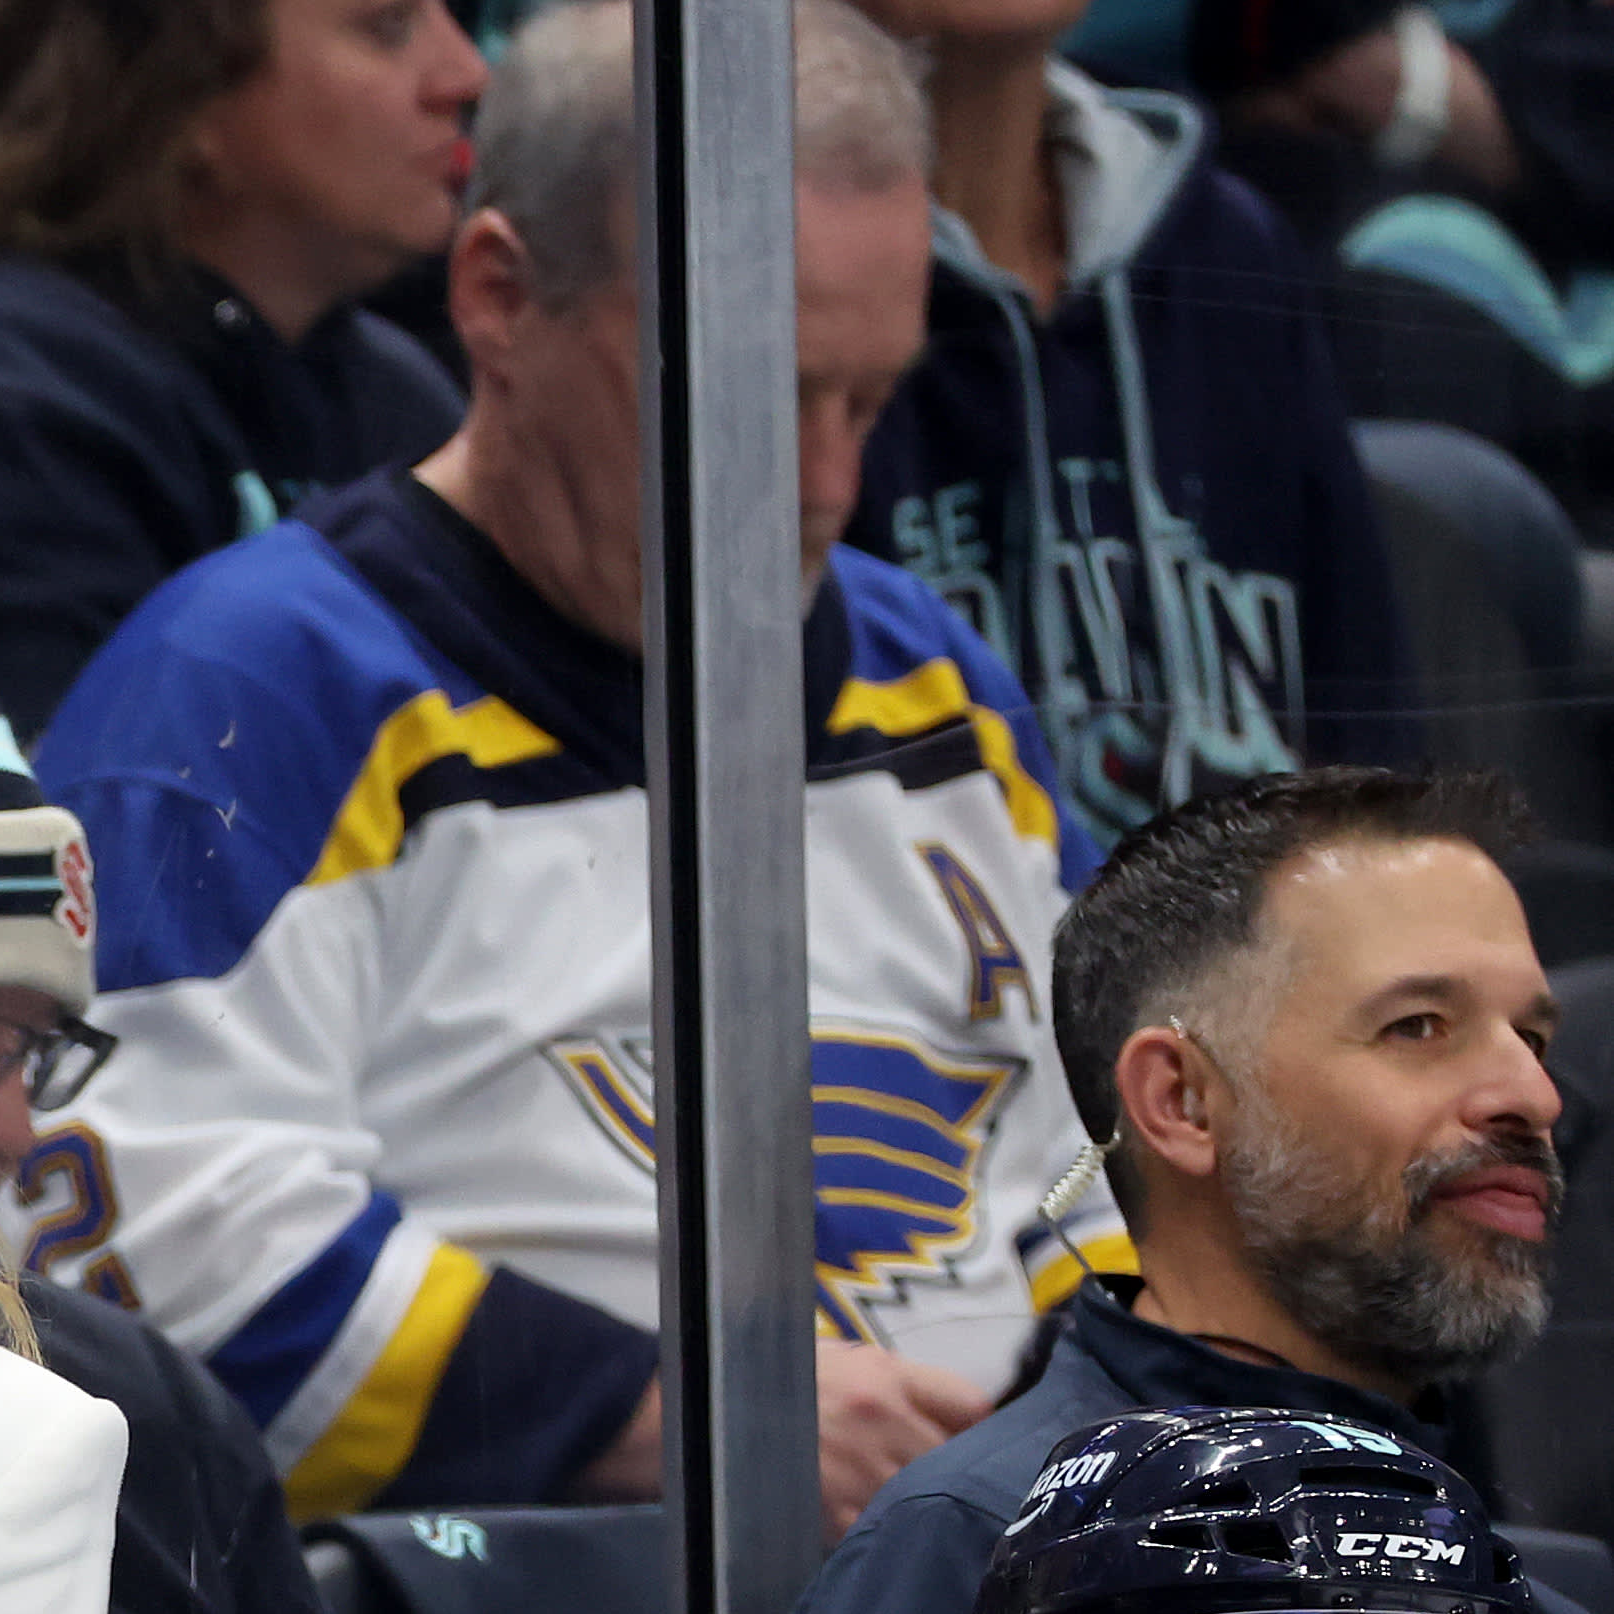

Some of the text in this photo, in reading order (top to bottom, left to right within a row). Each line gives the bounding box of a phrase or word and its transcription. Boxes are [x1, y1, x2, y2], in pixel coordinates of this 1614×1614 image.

[914, 840, 1040, 1025] A
[1021, 1451, 1118, 1502] azon
[1336, 1533, 1467, 1565] CCM
